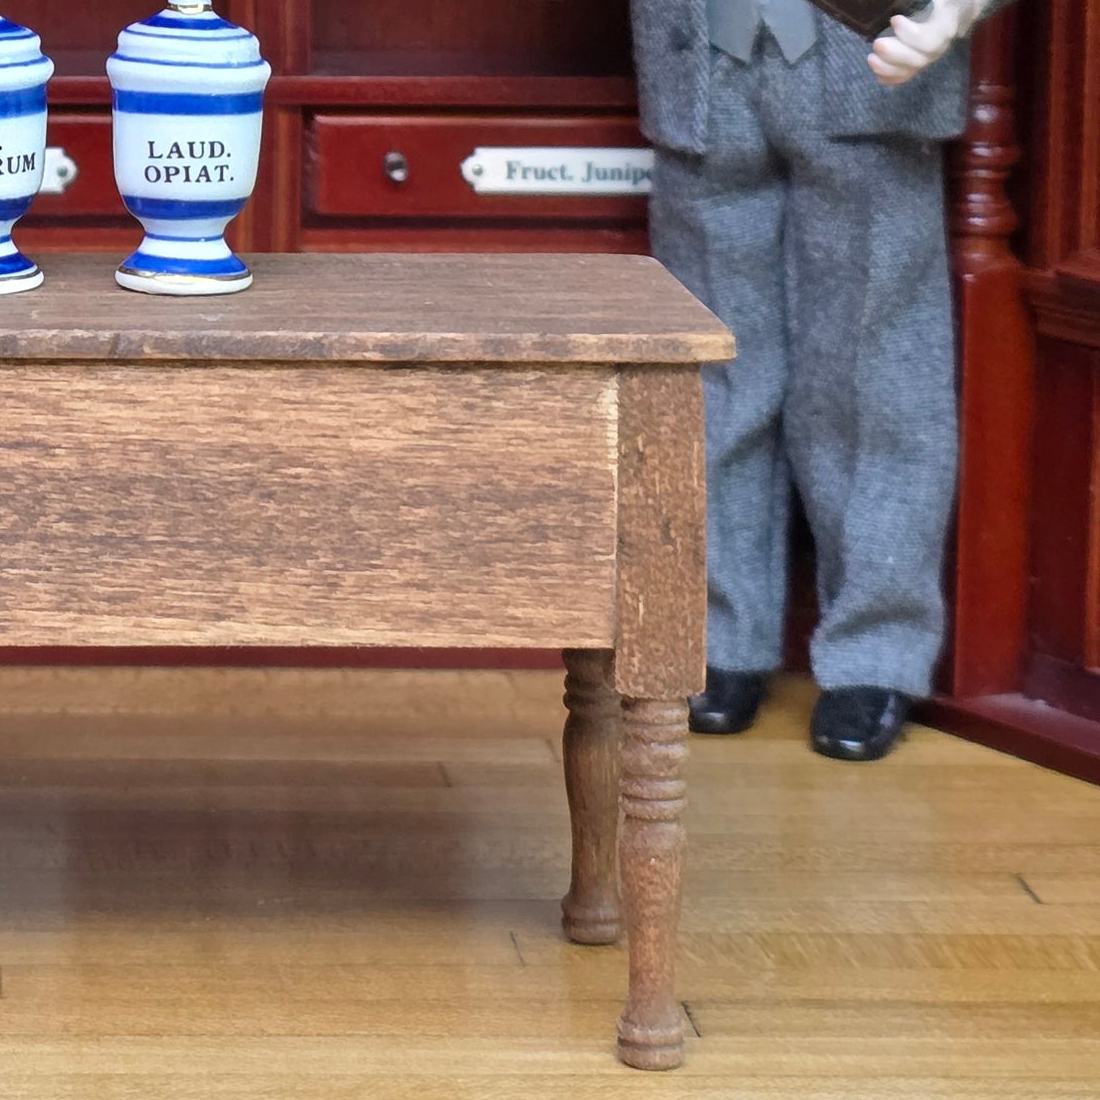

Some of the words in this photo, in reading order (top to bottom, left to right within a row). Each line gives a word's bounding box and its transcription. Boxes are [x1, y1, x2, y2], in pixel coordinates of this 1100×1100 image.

[147, 141, 232, 159] LAUD.
[144, 164, 235, 183] OPIAT.
[505, 160, 574, 181] Fruct.
